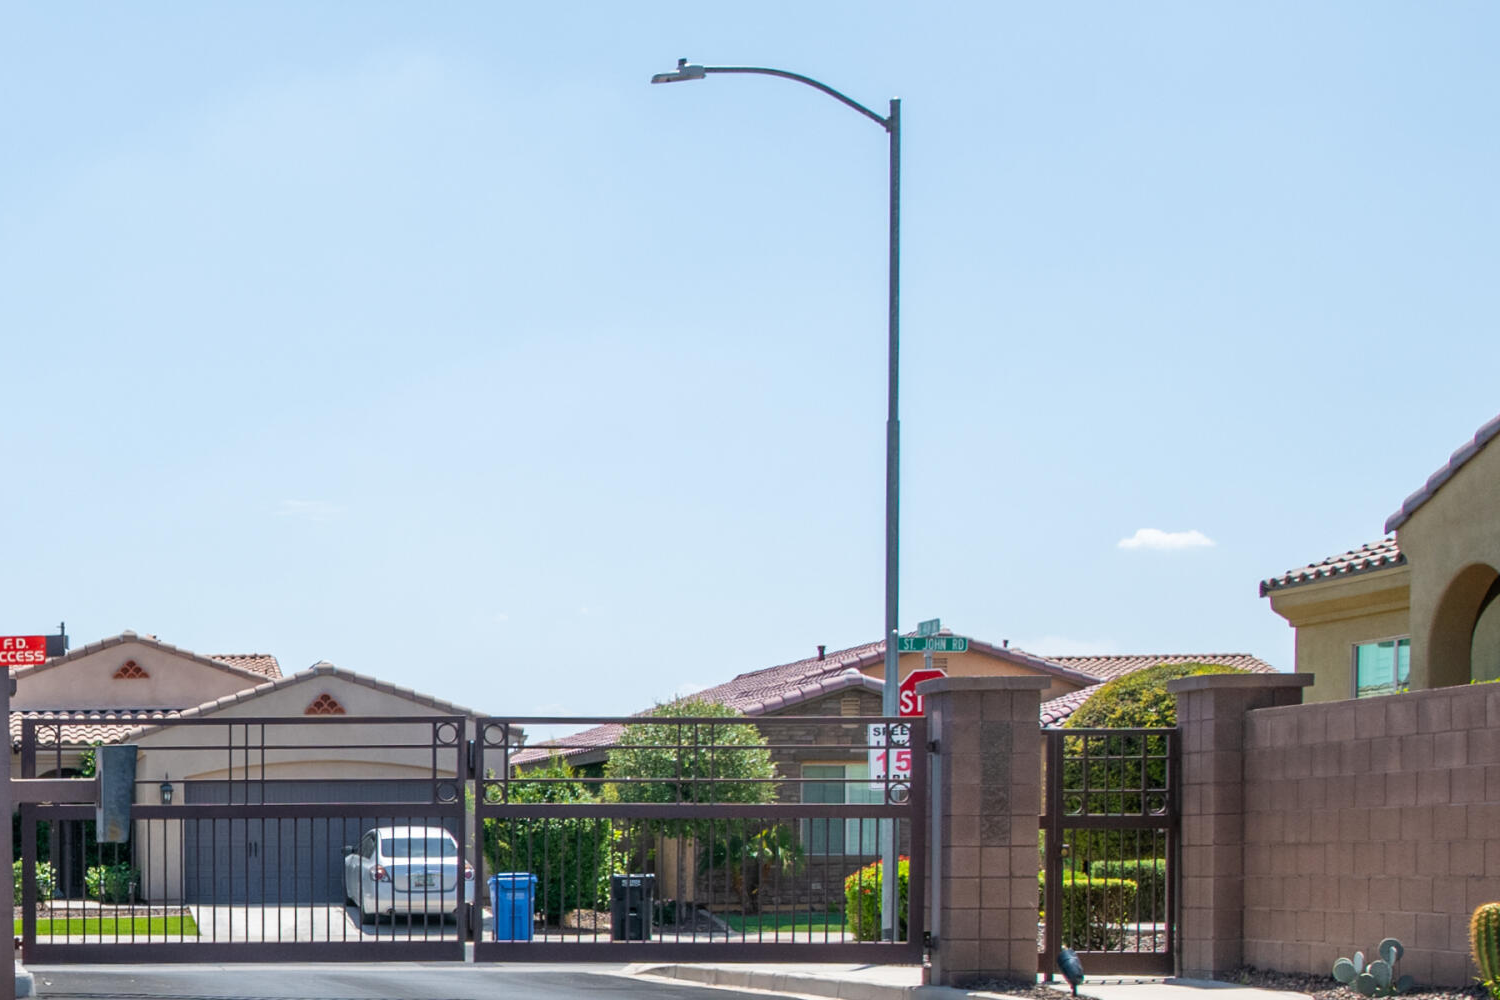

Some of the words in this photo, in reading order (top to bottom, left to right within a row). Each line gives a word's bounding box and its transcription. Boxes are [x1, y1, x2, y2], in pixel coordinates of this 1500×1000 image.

[4, 638, 29, 650] F.D.
[925, 639, 947, 650] JOHN
[952, 639, 965, 650] RD
[900, 690, 923, 713] ST
[876, 751, 912, 772] 15
